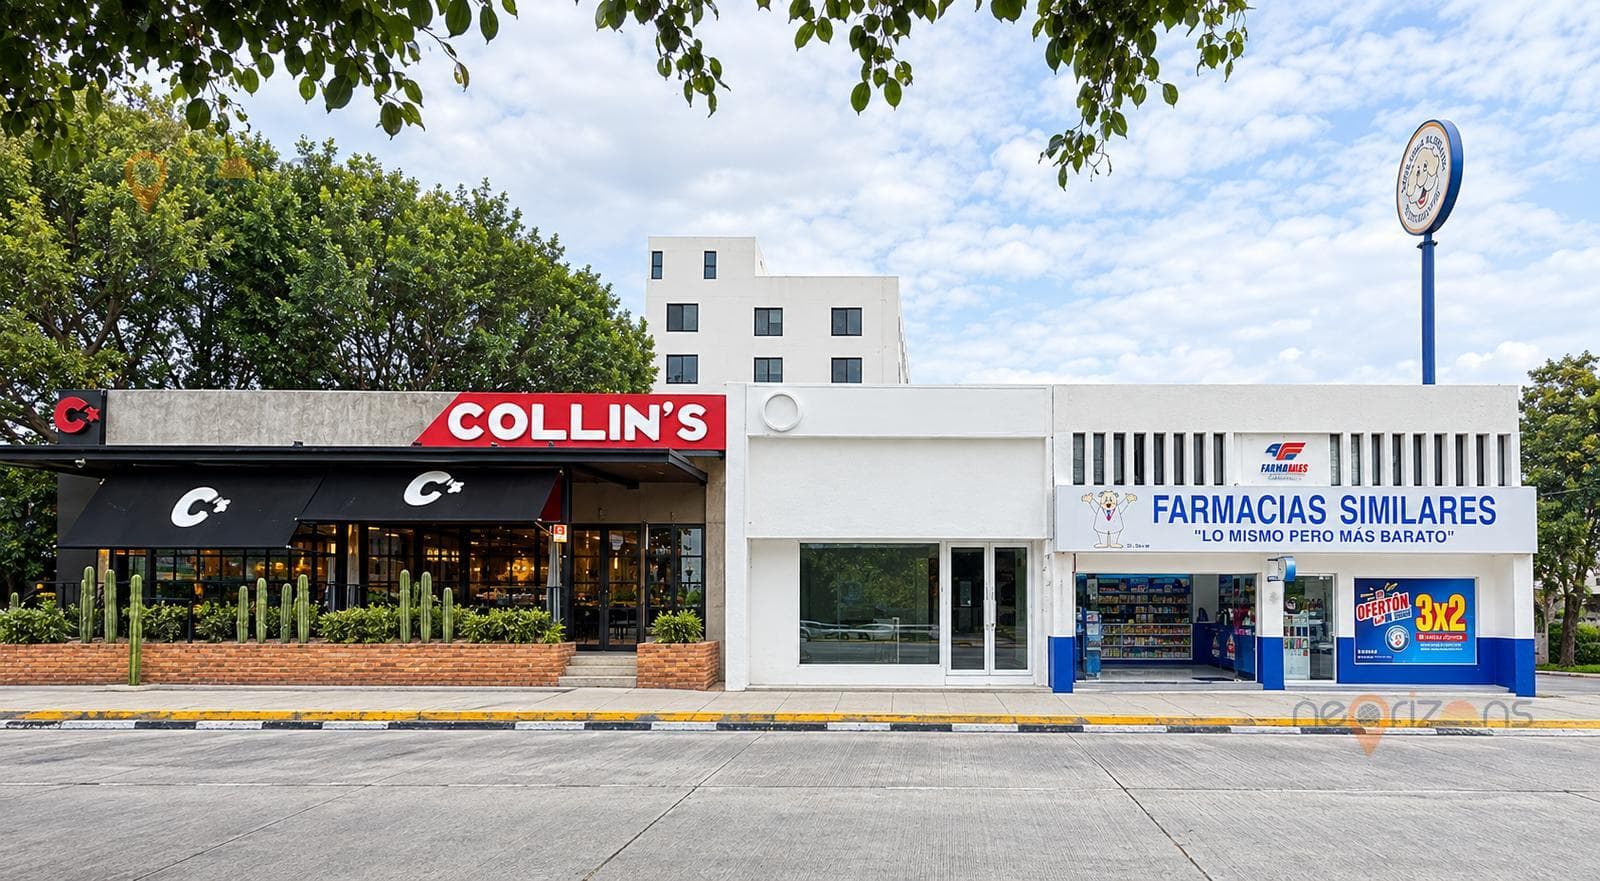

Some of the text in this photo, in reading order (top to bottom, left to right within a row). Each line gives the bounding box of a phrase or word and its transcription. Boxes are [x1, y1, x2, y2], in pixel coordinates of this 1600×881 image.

[447, 401, 708, 442] COLLIN'S
[1153, 494, 1497, 526] FARMACIAS SIMILARES
[1194, 526, 1455, 544] "LO MISMO PERO MÁS BARATO"
[1357, 592, 1409, 620] OFERTÓN
